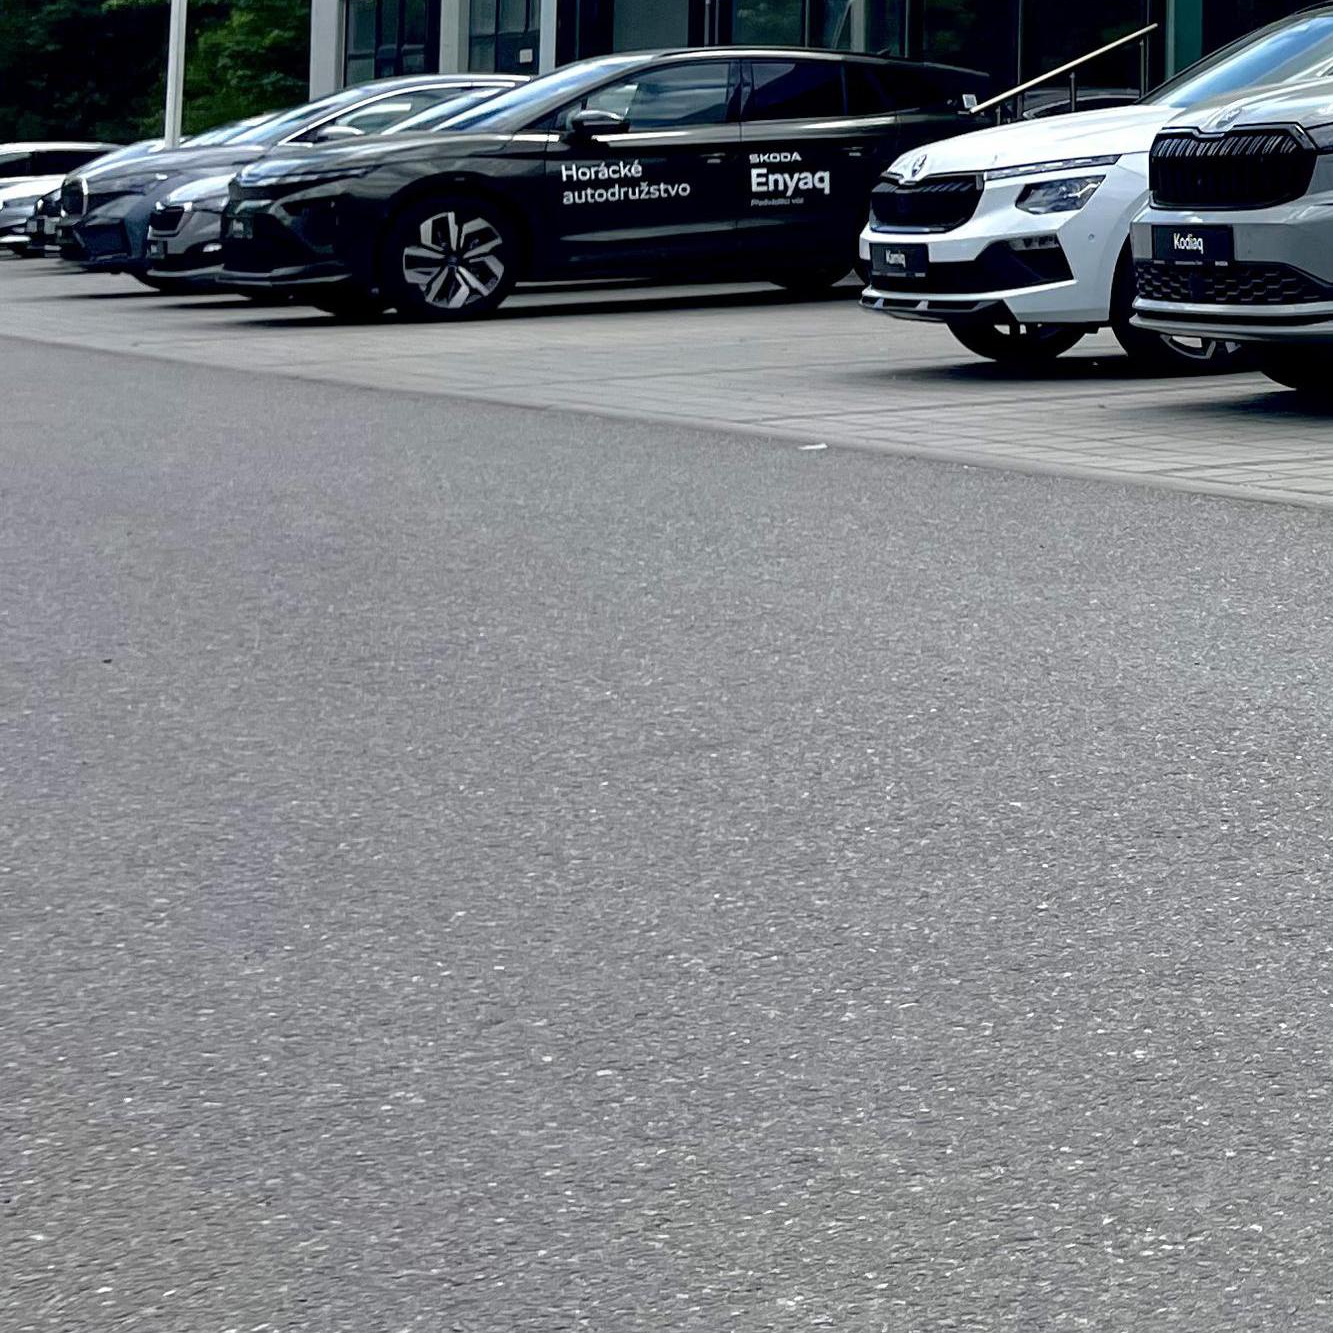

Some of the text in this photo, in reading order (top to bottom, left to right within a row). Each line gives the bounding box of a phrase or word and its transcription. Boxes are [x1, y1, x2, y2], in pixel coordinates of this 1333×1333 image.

[561, 159, 642, 182] Horácké
[750, 167, 831, 197] Enyaq
[562, 181, 691, 205] autodružstvo
[1173, 232, 1204, 255] Kodiaq
